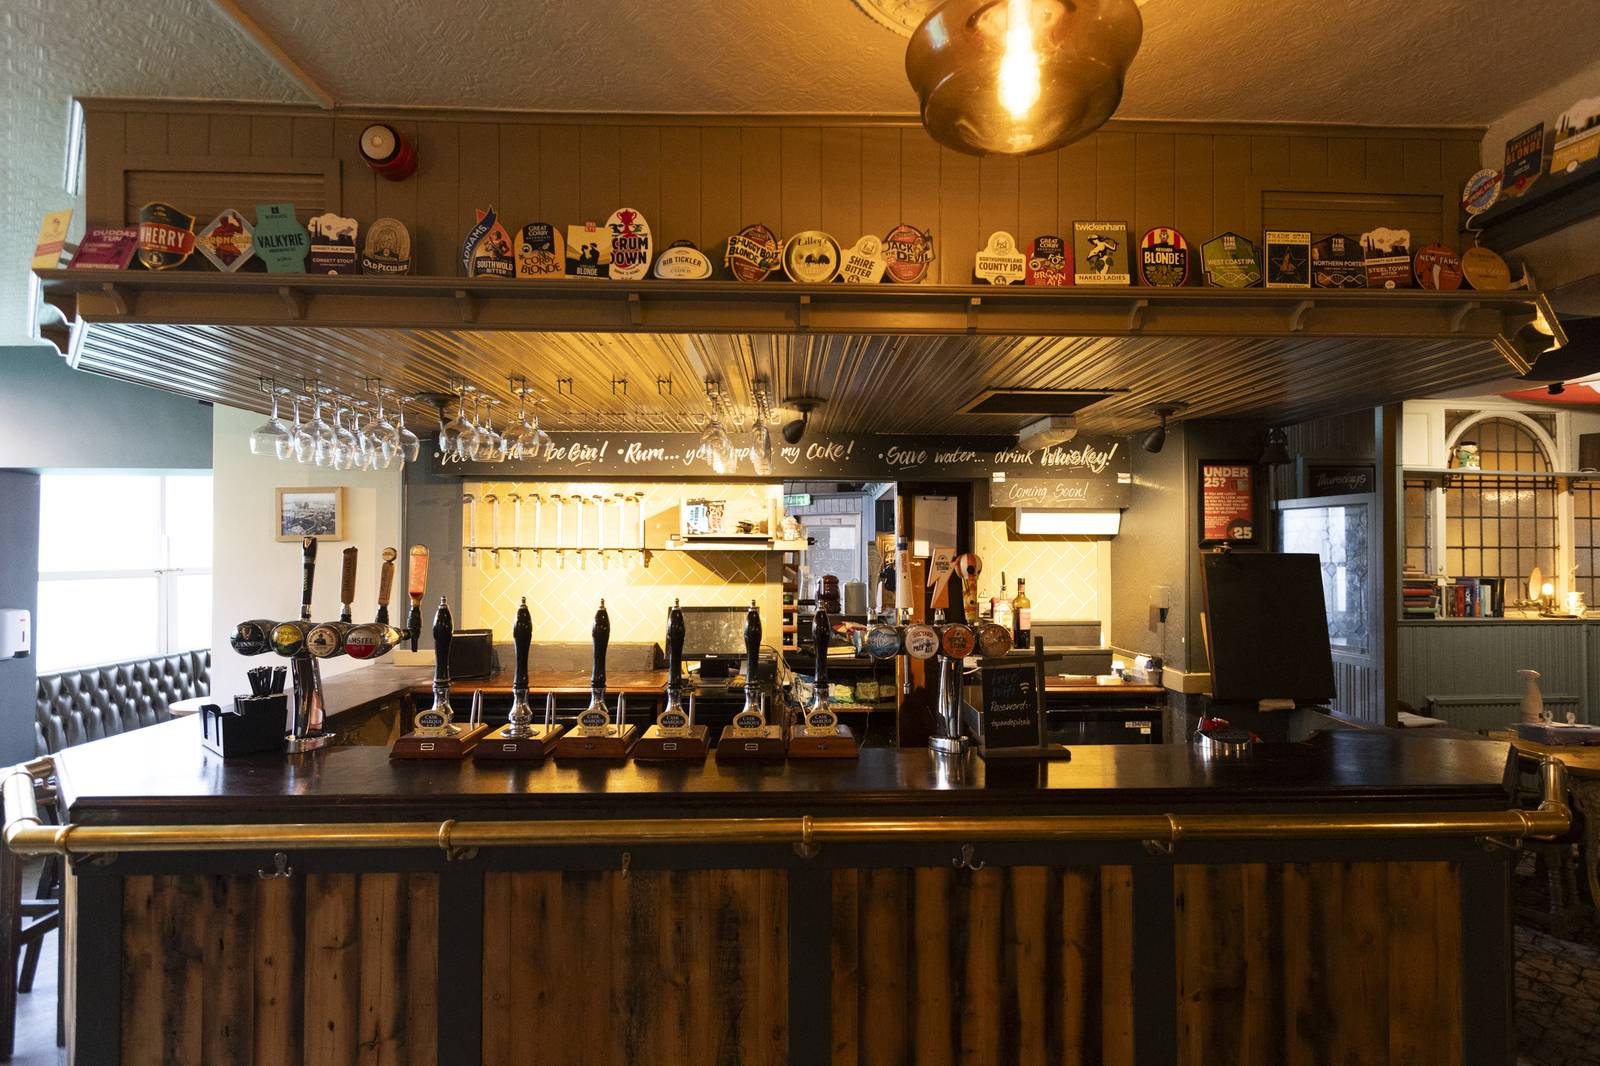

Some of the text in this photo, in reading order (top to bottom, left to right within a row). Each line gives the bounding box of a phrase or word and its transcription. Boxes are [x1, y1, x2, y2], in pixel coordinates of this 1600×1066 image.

[1075, 223, 1126, 231] twickenham
[257, 233, 305, 249] VALKYRIE
[463, 224, 488, 270] ADNAMS
[611, 237, 648, 250] CRUM
[729, 237, 760, 254] SHUGGY
[887, 241, 913, 253] JACK
[524, 256, 555, 266] CORBY
[729, 246, 759, 264] BLONDE
[897, 251, 930, 263] DEVIL
[1144, 251, 1180, 265] BLONDE
[476, 260, 513, 271] SOUTHWOLD
[675, 256, 702, 267] TICKLER
[849, 255, 875, 270] SHIRE
[978, 262, 1023, 272] COUNTY IPA
[520, 263, 562, 275] BLONDE
[577, 266, 598, 276] BLONDE
[845, 266, 872, 278] BITTER
[1034, 270, 1066, 281] BROWN
[1046, 279, 1062, 287] ALE
[568, 441, 609, 463] Gin!
[625, 442, 680, 464] Rum...
[781, 447, 800, 465] my
[885, 446, 928, 465] Save
[934, 446, 985, 463] water...
[994, 449, 1035, 464] drink
[1204, 467, 1249, 477] UNDER
[1204, 477, 1226, 488] 25?
[1008, 482, 1089, 502] Coming Soon!
[1233, 527, 1253, 540] 25
